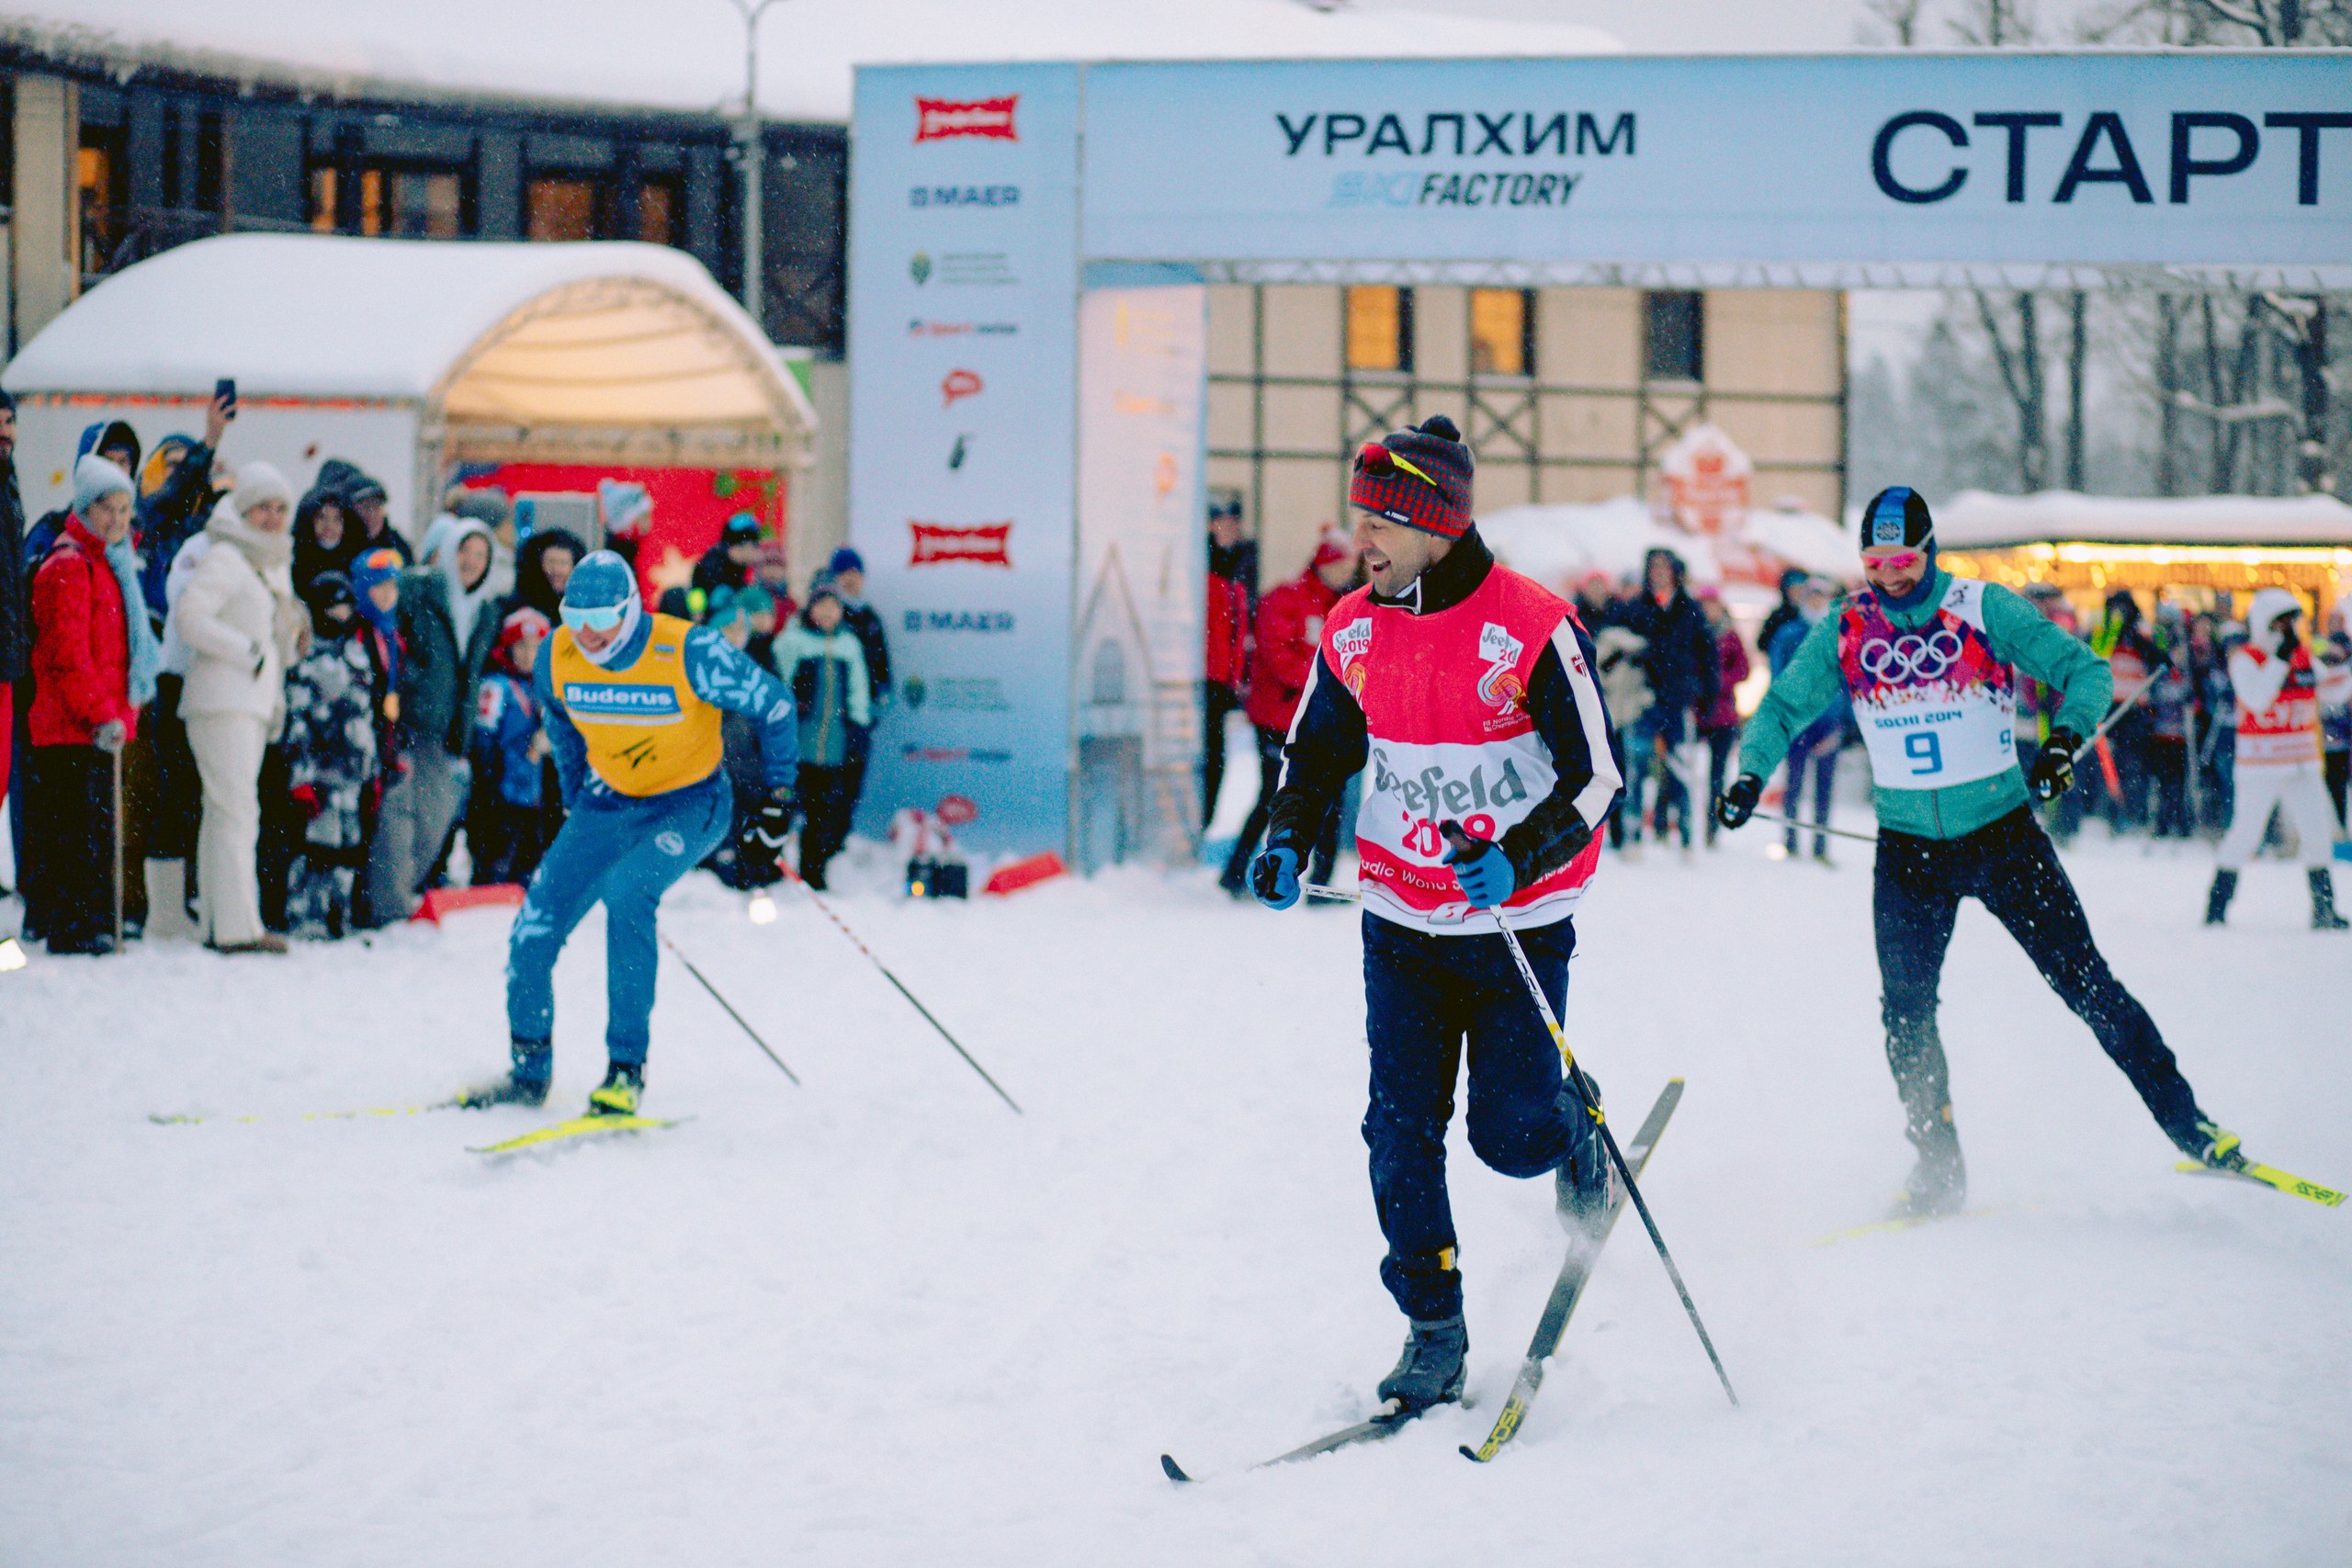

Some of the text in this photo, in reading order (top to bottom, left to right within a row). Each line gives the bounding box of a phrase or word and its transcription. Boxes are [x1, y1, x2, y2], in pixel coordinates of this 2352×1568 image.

[1275, 112, 1636, 155] УРАЛХИМ
[1871, 109, 2352, 205] СТАРТ
[1419, 173, 1582, 206] FACTORY
[1341, 639, 1370, 653] 2019
[567, 685, 673, 705] Buderus
[1874, 710, 1962, 728] SOCHI 2014
[1905, 731, 1943, 775] 9
[1999, 728, 2012, 754] 9
